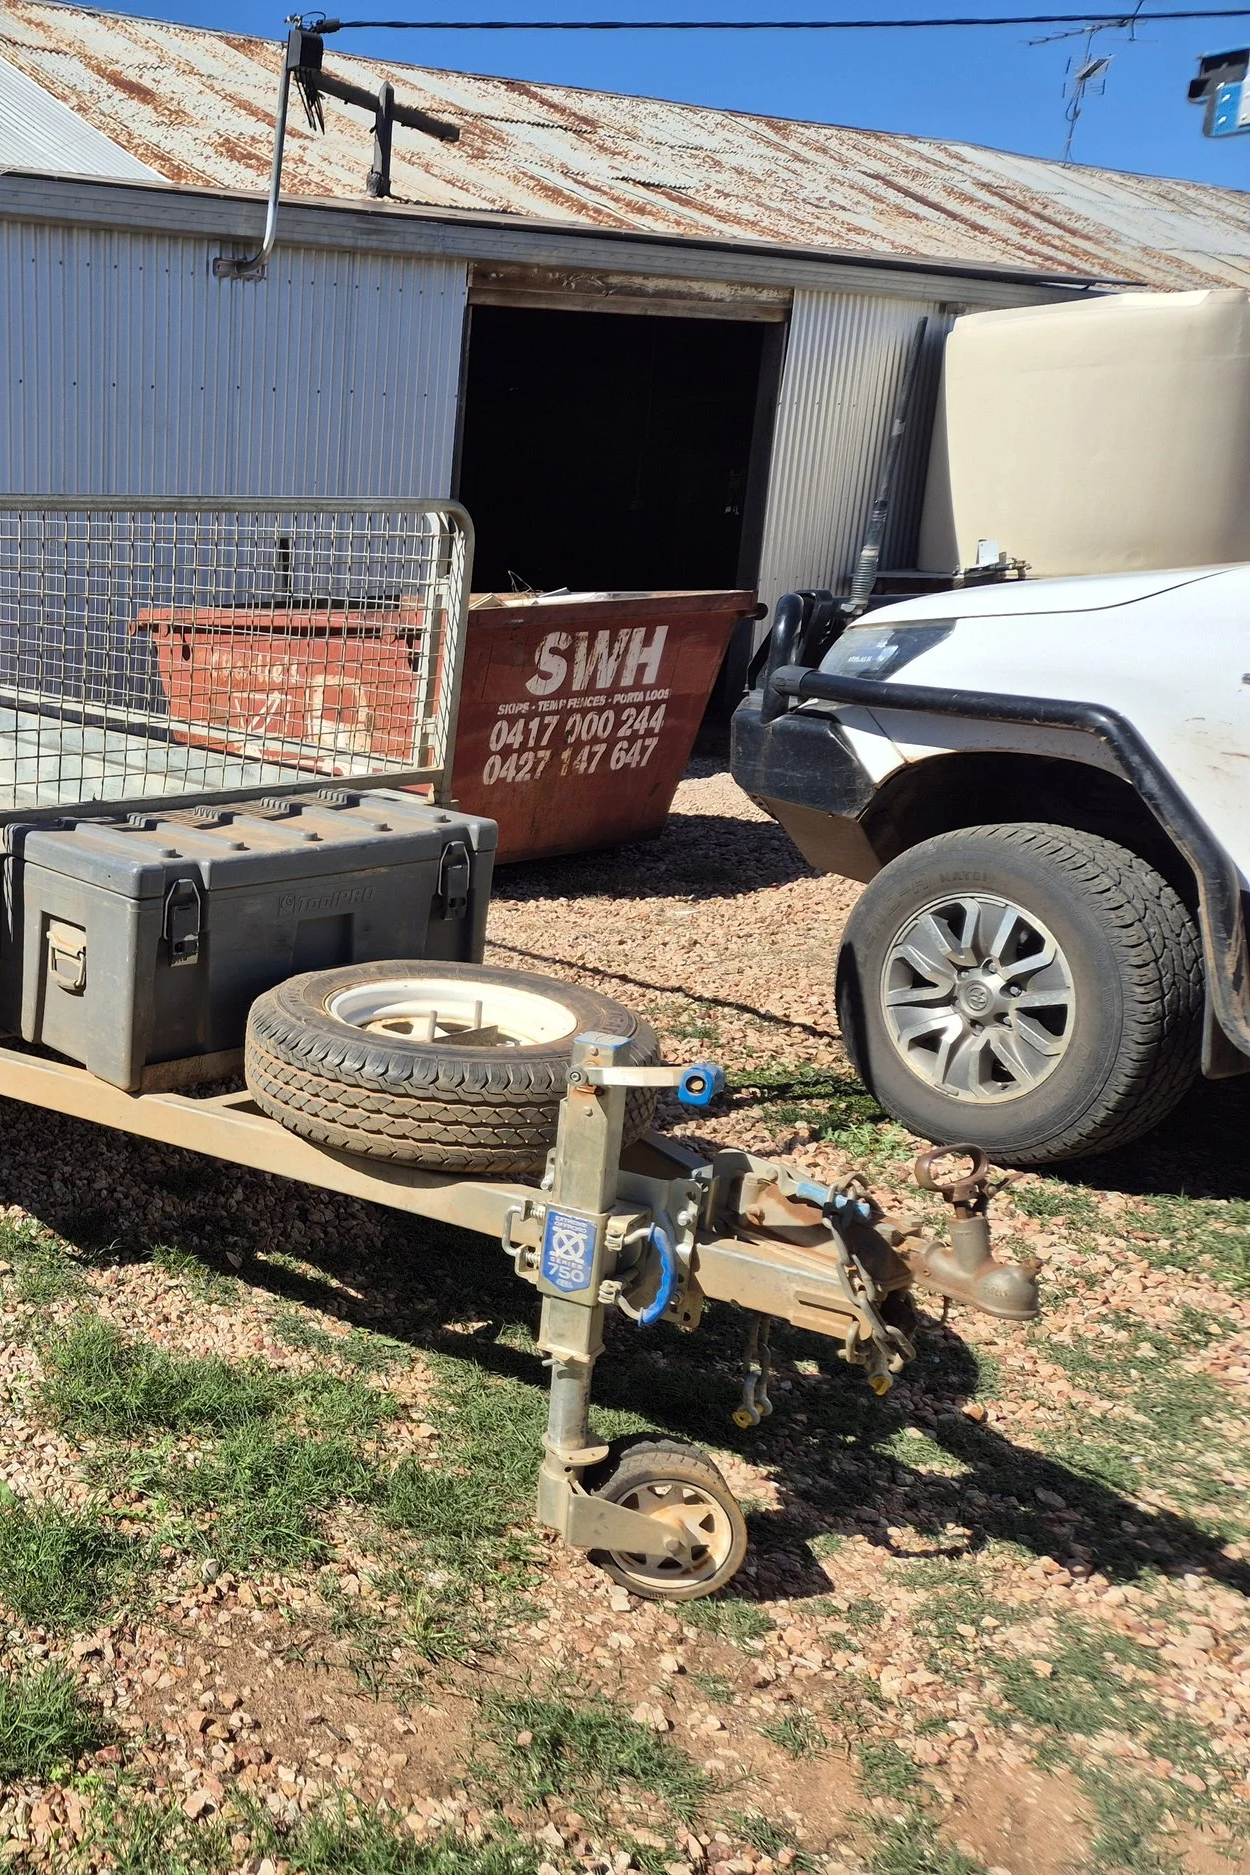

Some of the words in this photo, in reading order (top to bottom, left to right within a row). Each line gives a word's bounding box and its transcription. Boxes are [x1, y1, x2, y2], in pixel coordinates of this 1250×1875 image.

[525, 625, 669, 695] SWH
[498, 702, 530, 715] SKIPS
[613, 691, 643, 703] PORTA
[645, 689, 671, 701] LOOS
[489, 714, 560, 752] 0417
[565, 709, 615, 744] 000
[617, 704, 666, 738] 244
[483, 749, 552, 785] 0427
[560, 743, 607, 776] 147
[610, 736, 659, 770] 647
[548, 1261, 585, 1283] 750
[549, 1256, 583, 1270] SERIES
